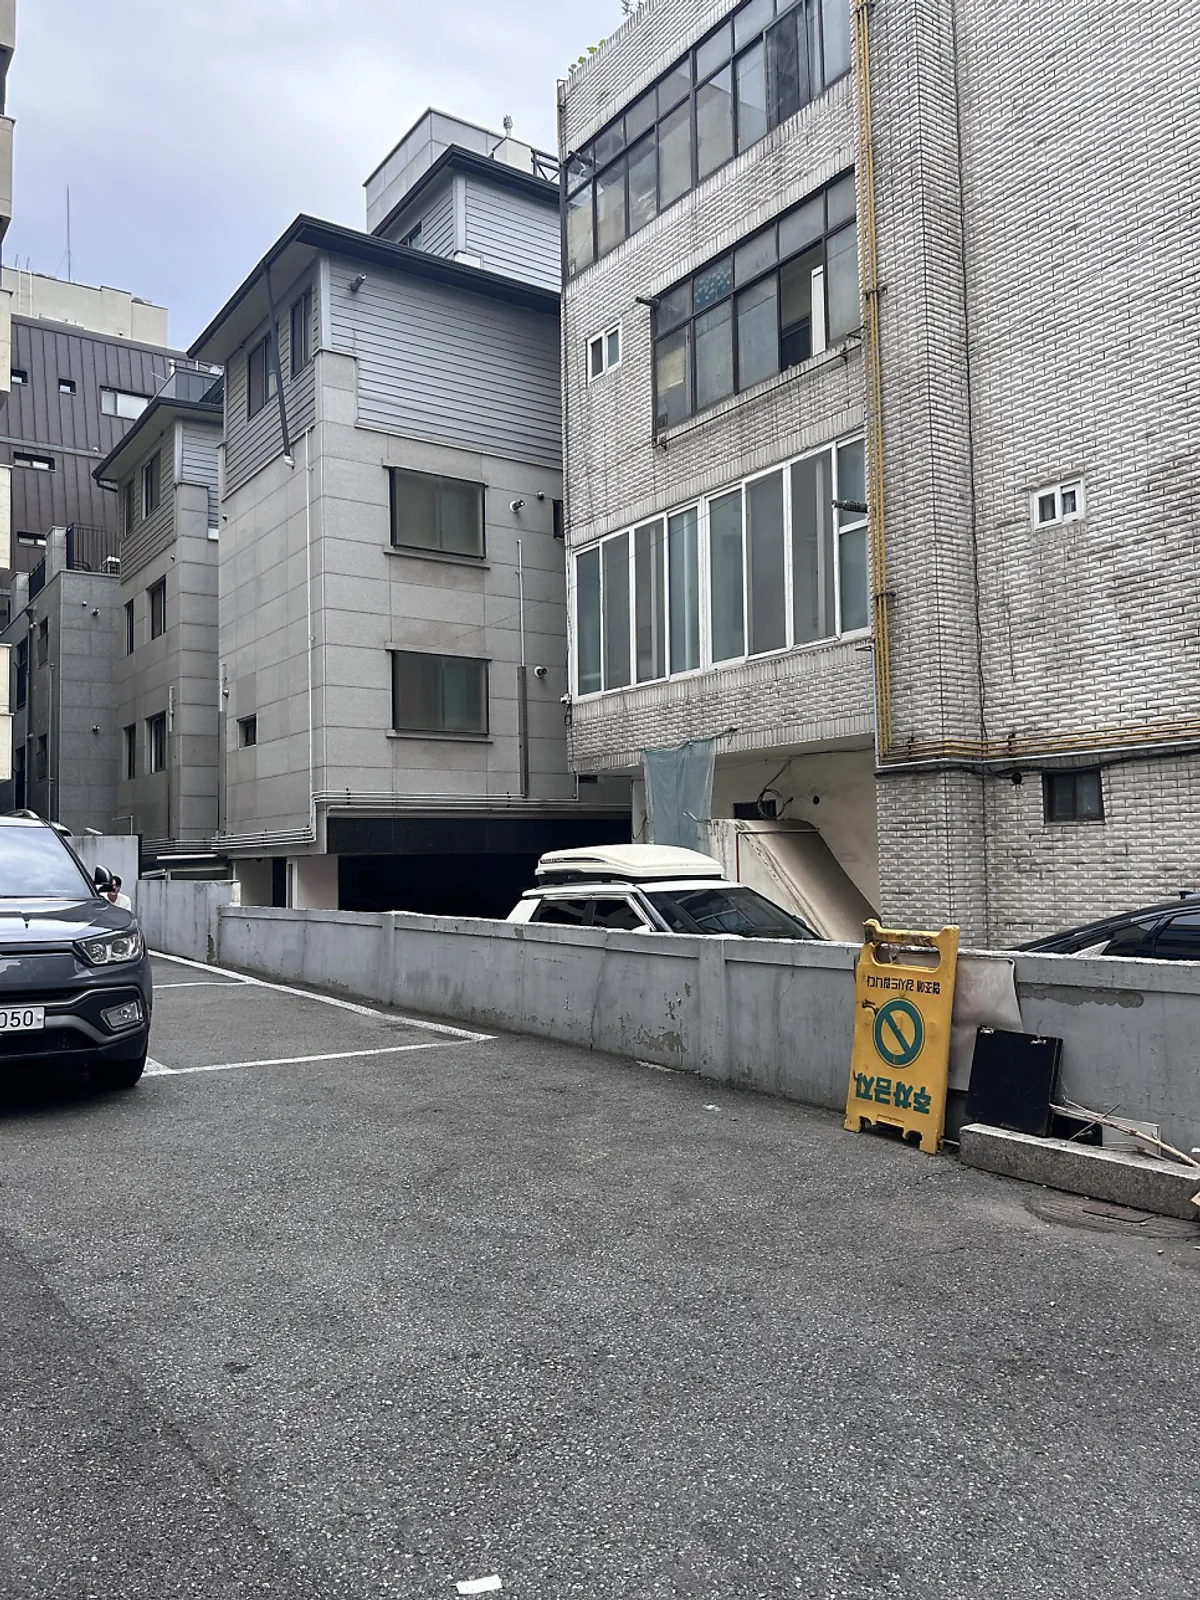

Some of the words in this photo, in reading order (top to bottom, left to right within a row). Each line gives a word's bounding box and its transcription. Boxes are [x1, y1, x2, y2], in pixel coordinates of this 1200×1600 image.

[866, 975, 915, 992] 감사드립니다
[917, 980, 940, 995] 협조에
[856, 1072, 932, 1115] 주차금지
